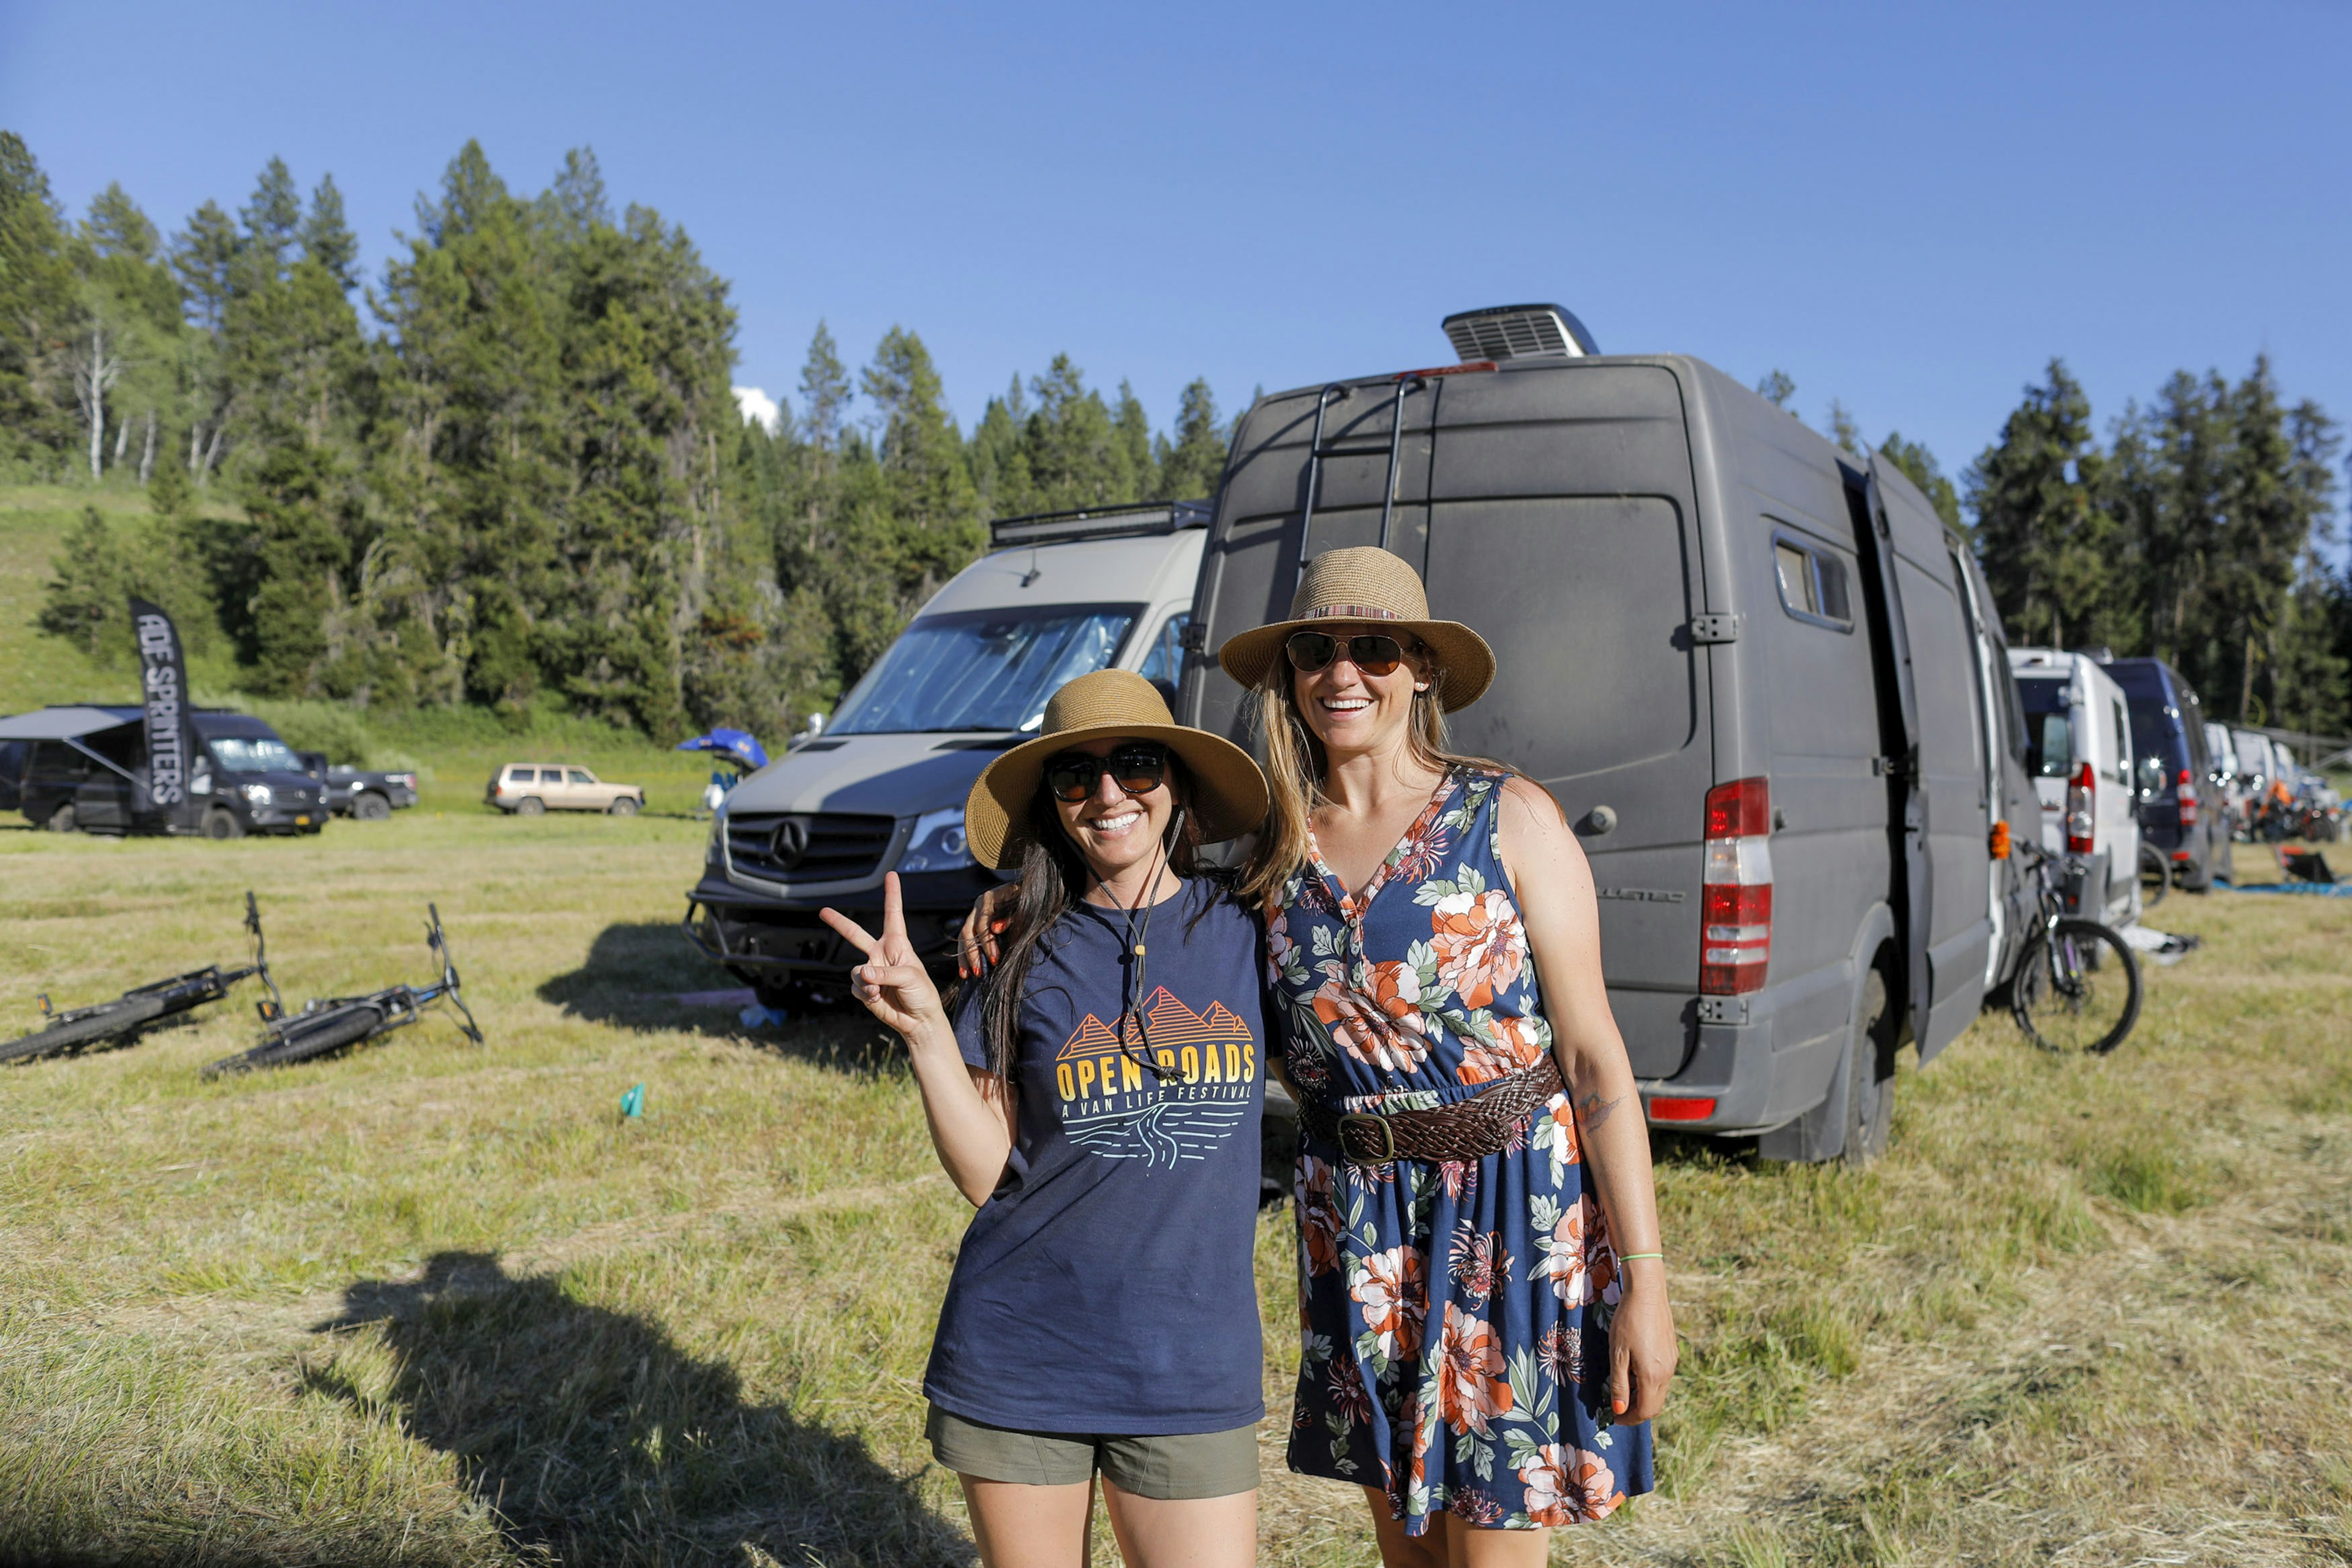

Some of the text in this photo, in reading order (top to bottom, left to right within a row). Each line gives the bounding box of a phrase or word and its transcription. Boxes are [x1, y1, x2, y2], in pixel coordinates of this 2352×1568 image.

[146, 666, 183, 805] SPRINTERS
[1055, 1044, 1255, 1102] OPEN ROADS
[1062, 1086, 1251, 1117] A VAN LIFE FESTIVAL
